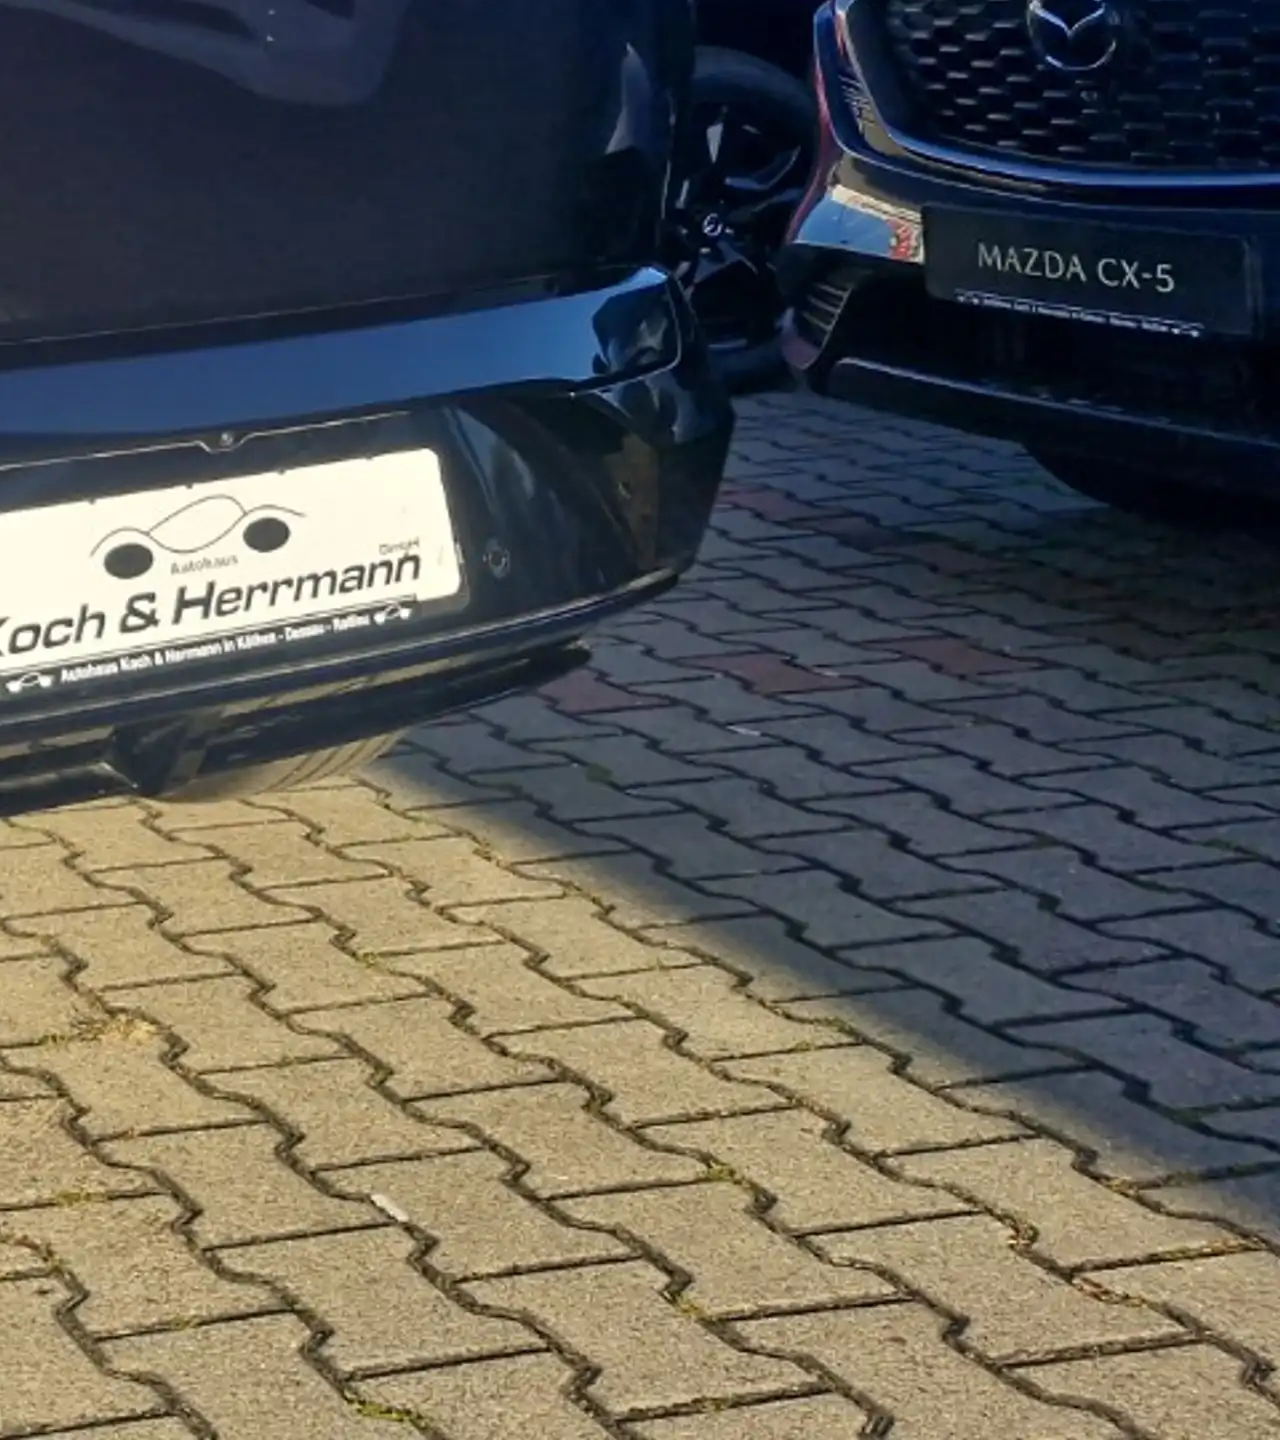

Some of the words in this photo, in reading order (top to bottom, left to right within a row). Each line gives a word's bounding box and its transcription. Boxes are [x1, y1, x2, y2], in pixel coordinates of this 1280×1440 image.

[977, 242, 1088, 283] MAZDA
[1096, 257, 1176, 293] CX-5
[170, 553, 239, 576] Autohaus
[119, 591, 161, 634] &
[171, 553, 421, 626] Herrmann
